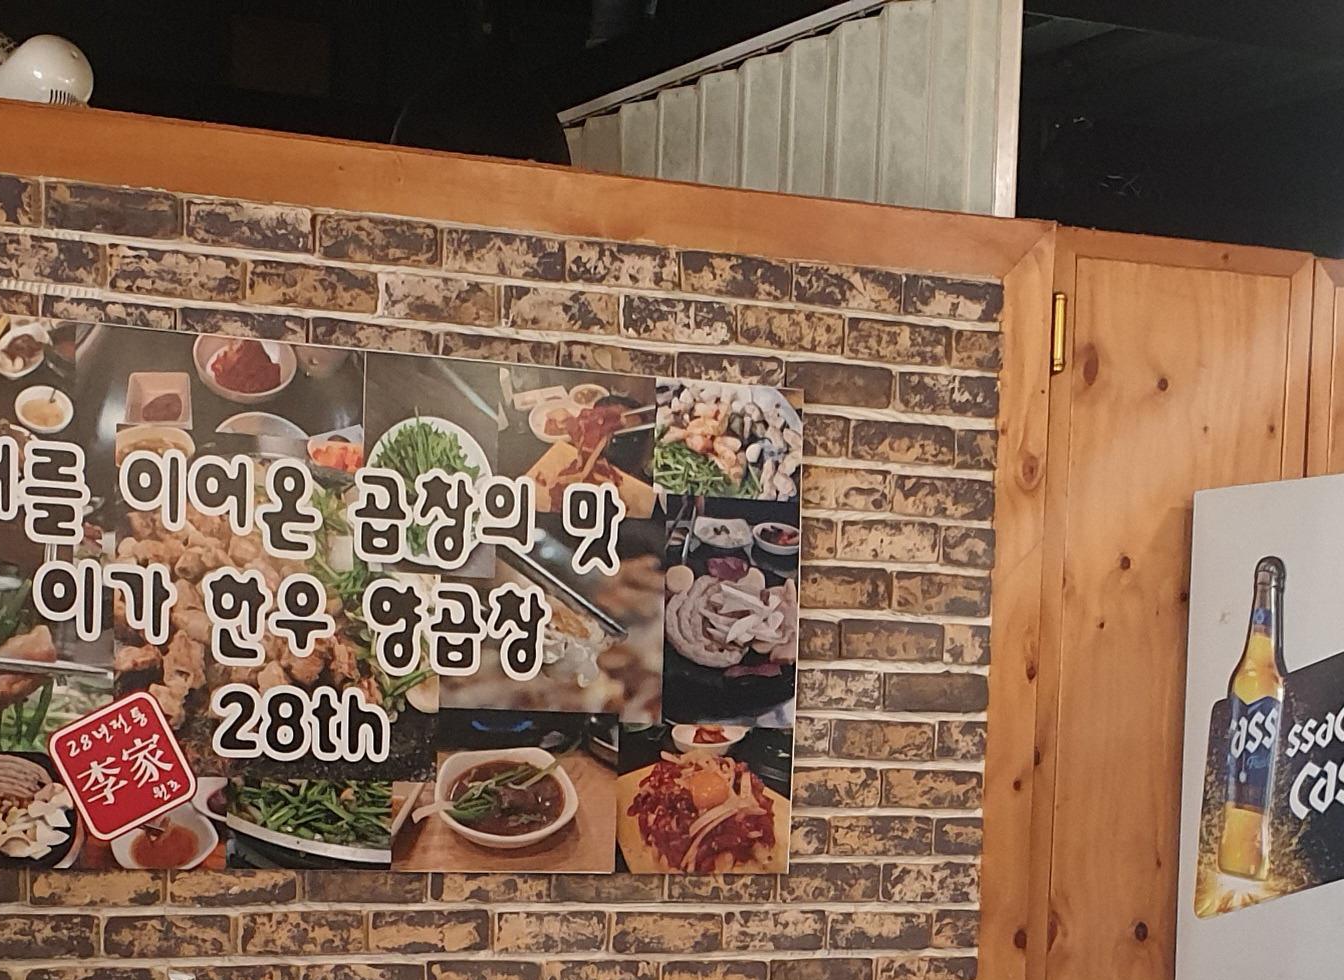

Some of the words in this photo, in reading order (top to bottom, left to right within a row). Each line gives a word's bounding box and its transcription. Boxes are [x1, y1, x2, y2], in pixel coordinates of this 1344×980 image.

[118, 449, 324, 560] 이어온
[351, 466, 537, 571] 곱창의
[561, 482, 626, 578] 맛
[32, 557, 178, 646] 이가
[202, 564, 336, 667] 한우
[361, 577, 553, 682] 양곱창
[66, 706, 149, 757] 28년전통
[211, 683, 392, 763] 28th
[76, 734, 174, 805] 李家
